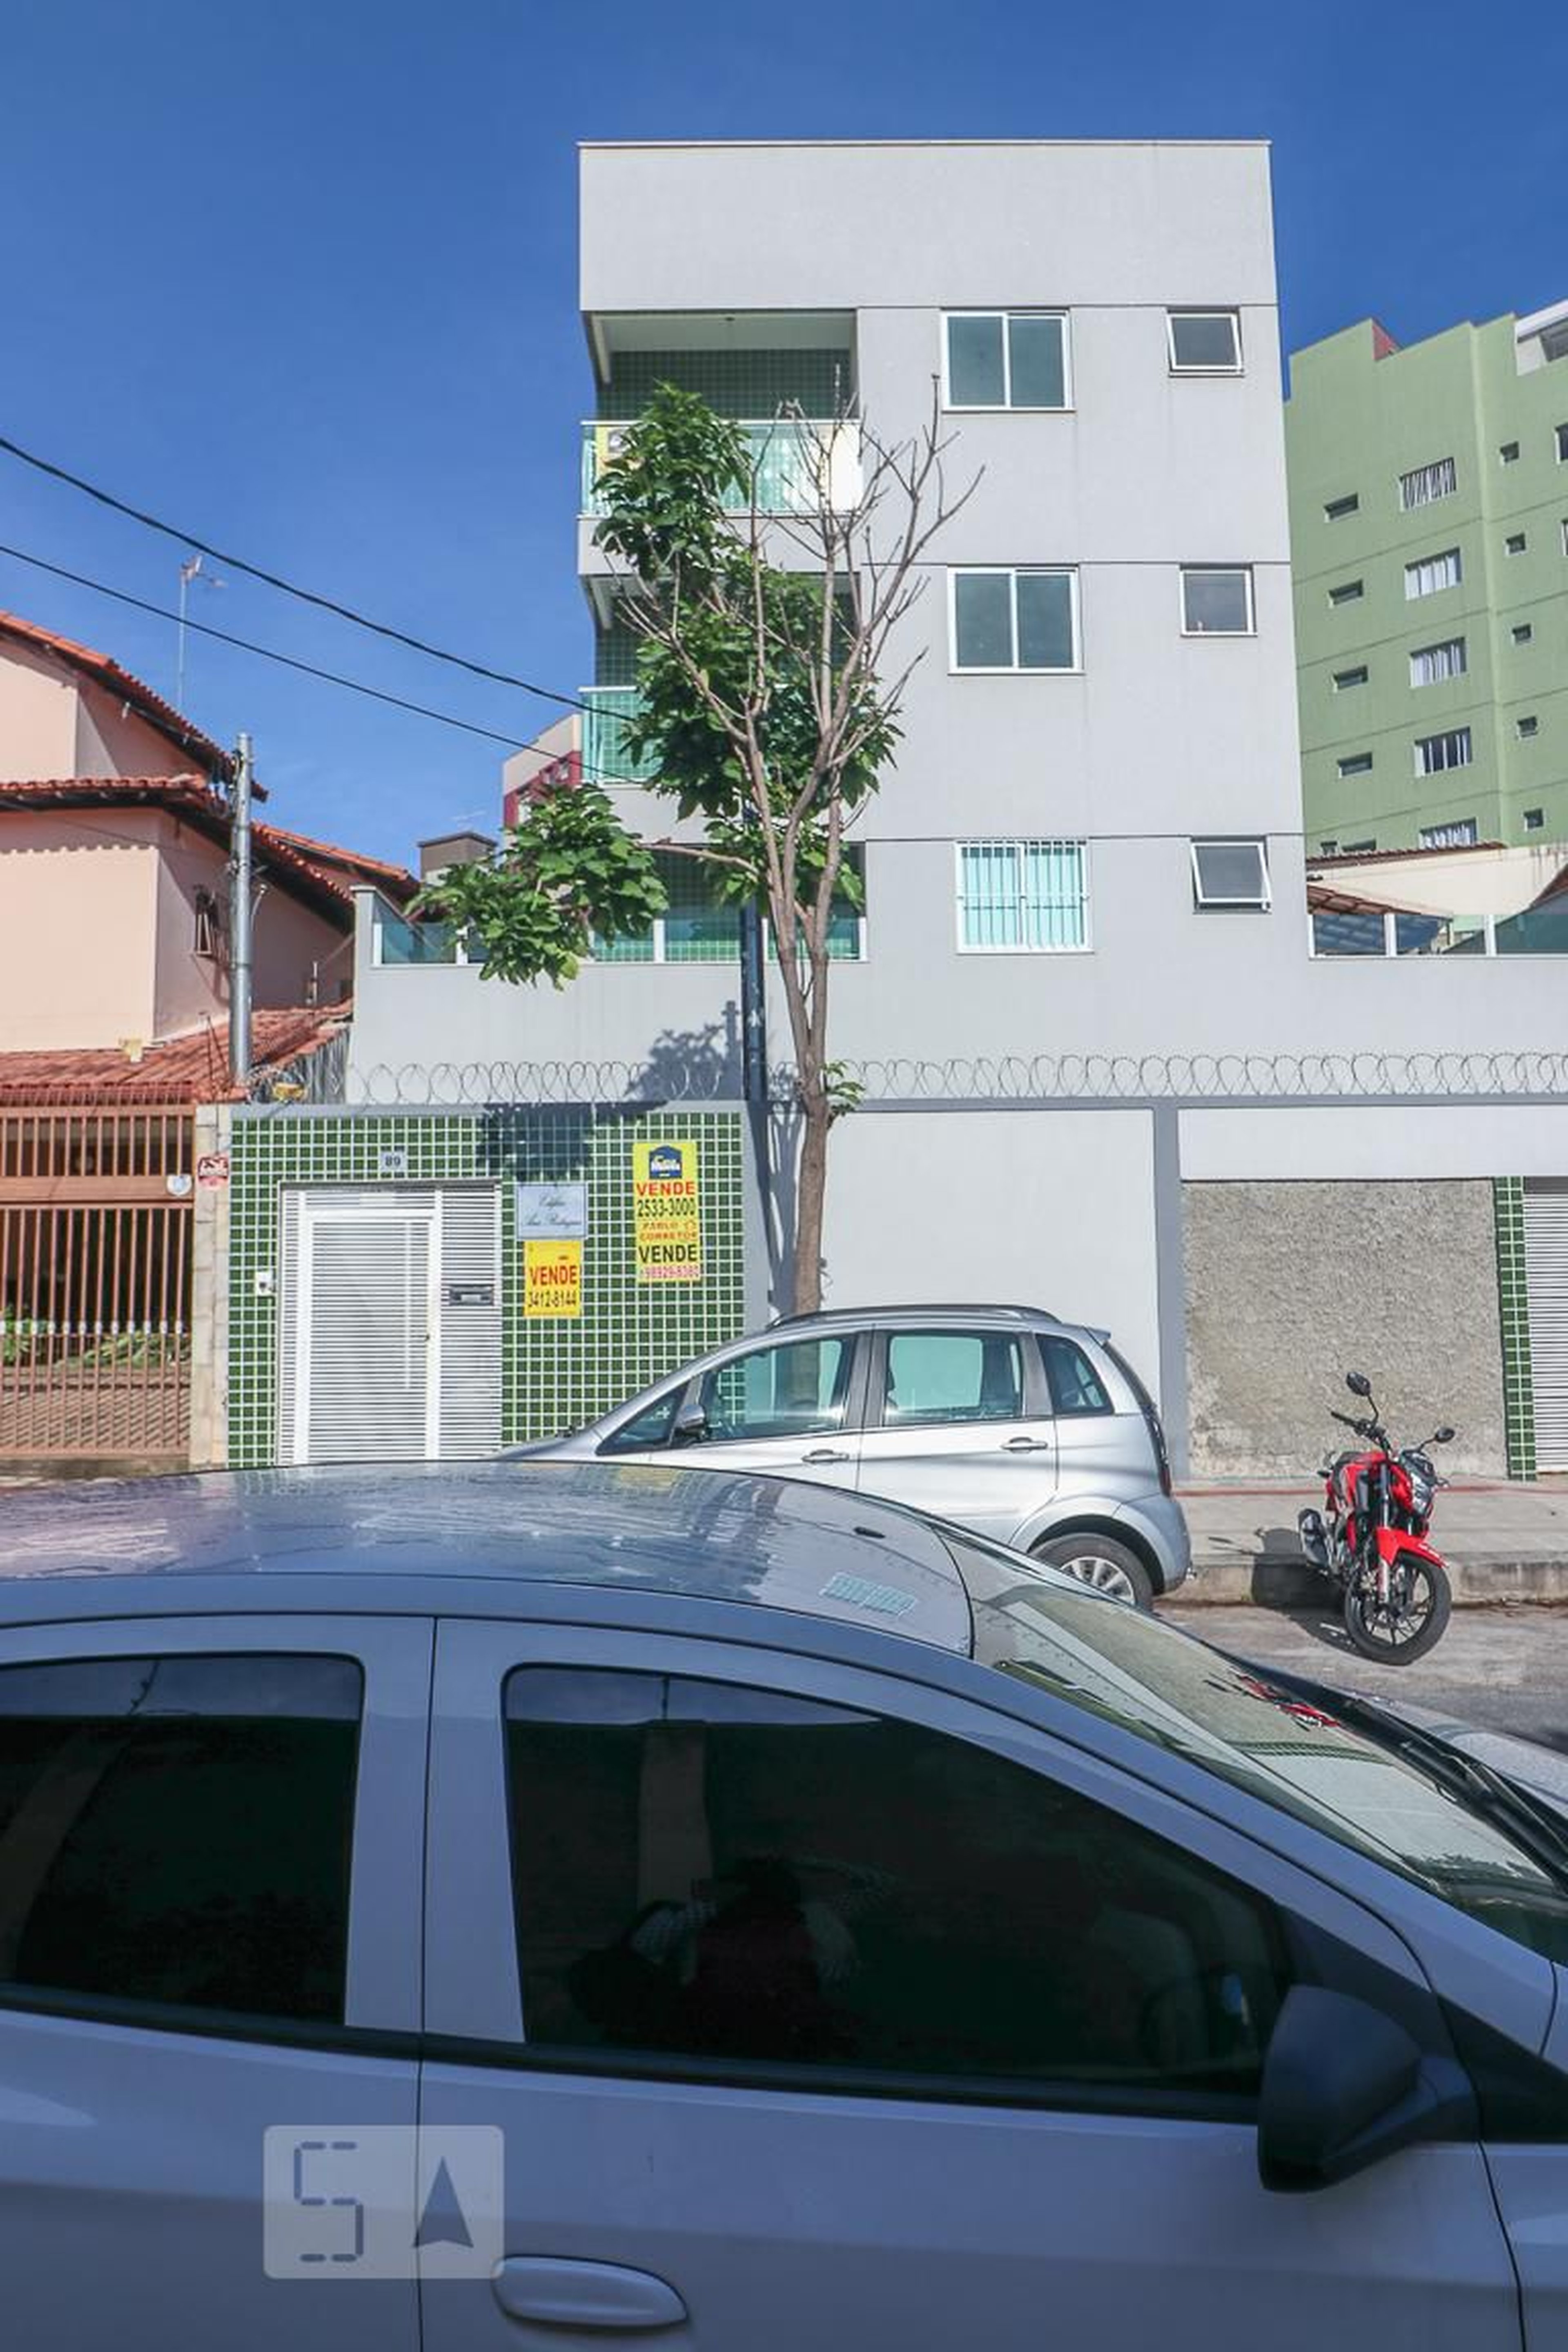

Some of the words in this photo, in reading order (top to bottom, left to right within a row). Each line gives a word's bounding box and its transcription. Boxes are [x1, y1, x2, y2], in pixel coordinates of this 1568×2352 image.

[385, 1155, 401, 1167] 89
[636, 1182, 695, 1196] VENDE
[637, 1197, 696, 1218] 2533-3000
[638, 1244, 697, 1264] VENDE
[529, 1265, 577, 1286] VENDE
[528, 1290, 577, 1308] 3412-8144
